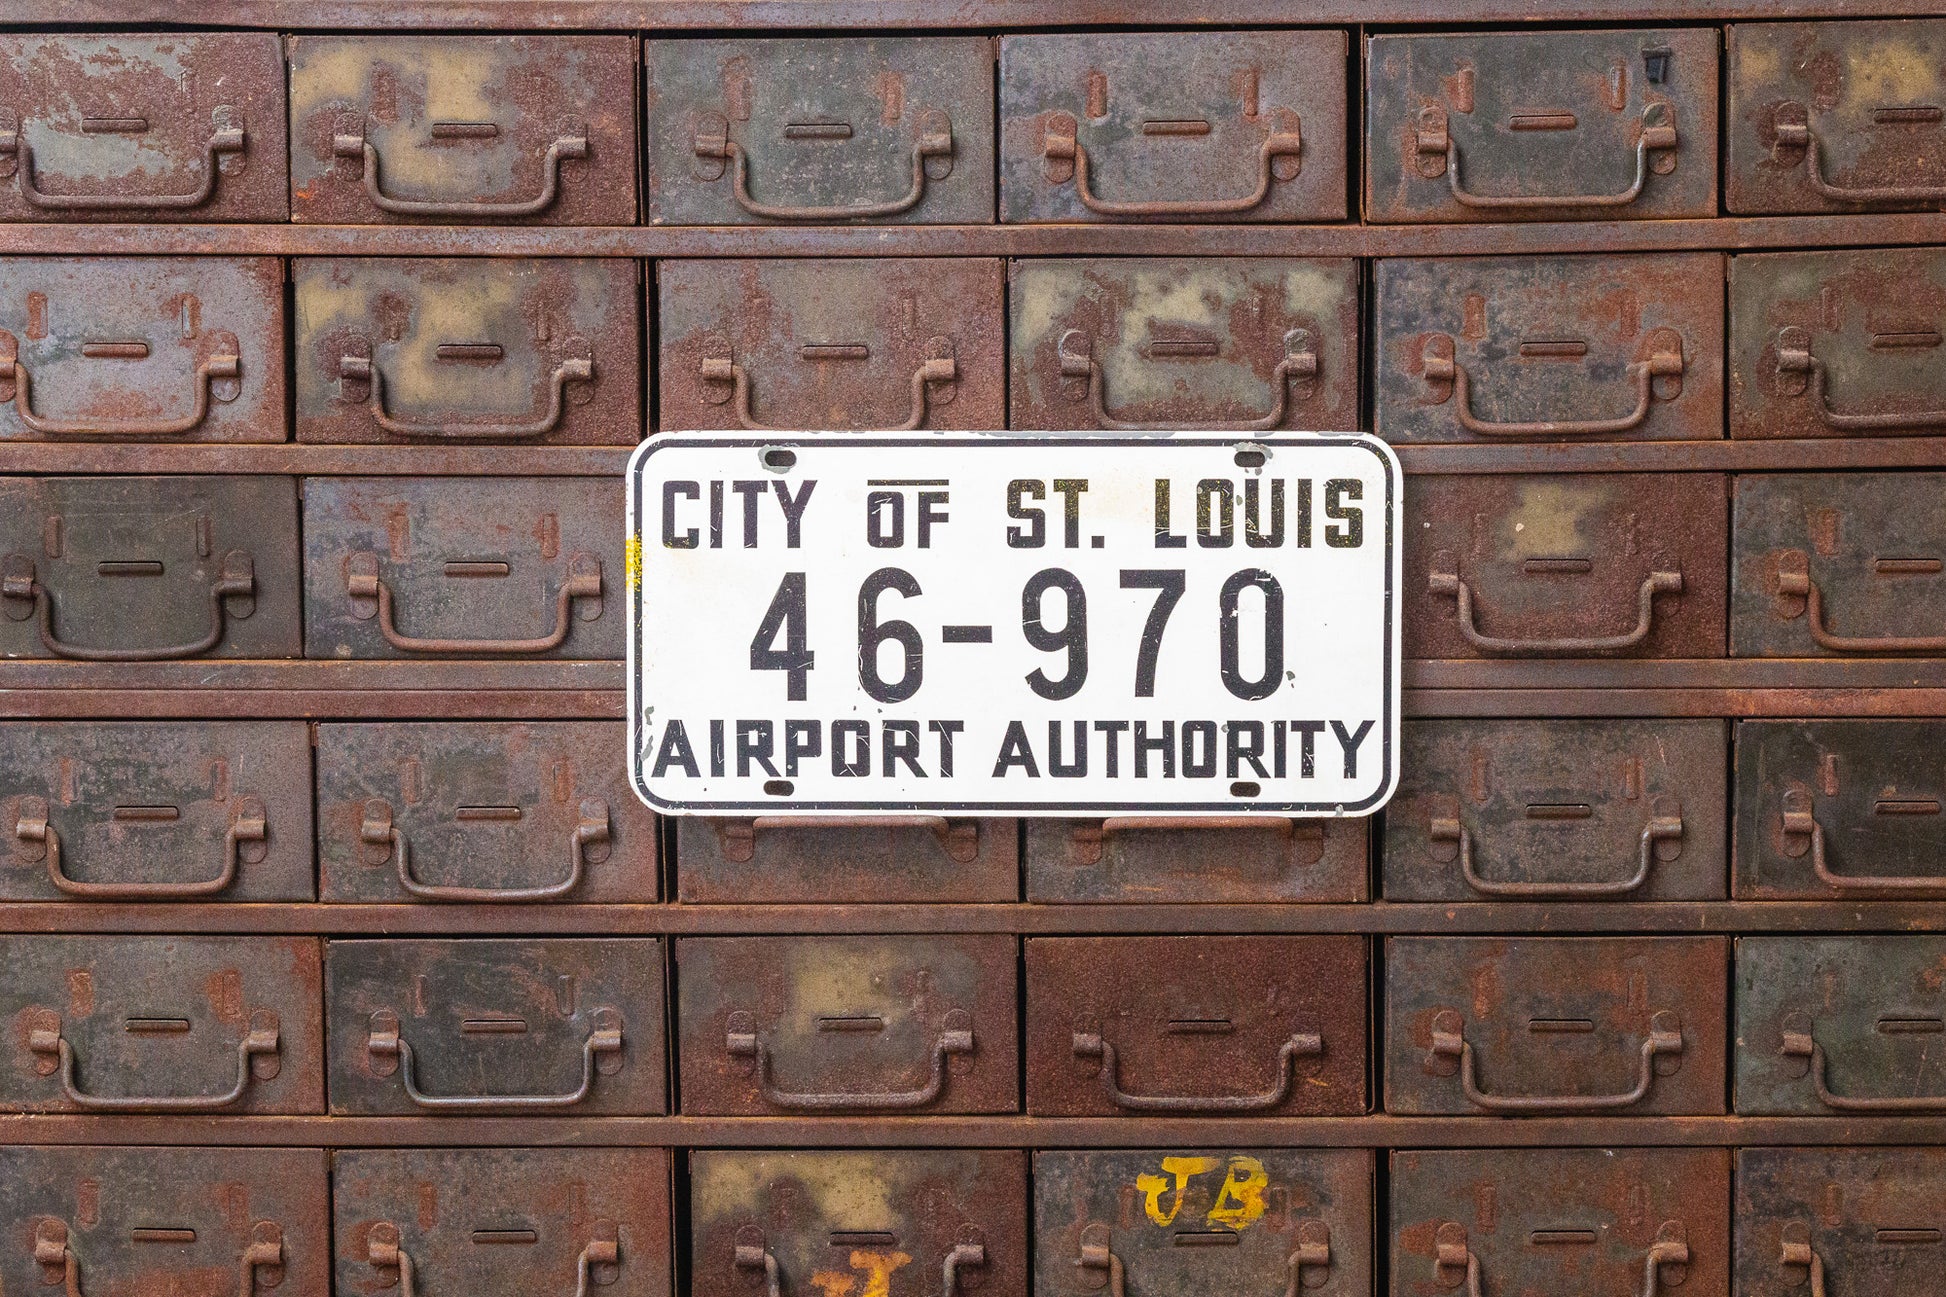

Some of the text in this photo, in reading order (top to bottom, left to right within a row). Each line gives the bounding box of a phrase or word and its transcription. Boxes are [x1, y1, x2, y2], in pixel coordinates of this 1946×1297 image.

[662, 479, 1363, 549] CITY OF ST. LOUIS
[750, 567, 1285, 704] 46-970
[651, 719, 1376, 778] AIRPORT AUTHORITY
